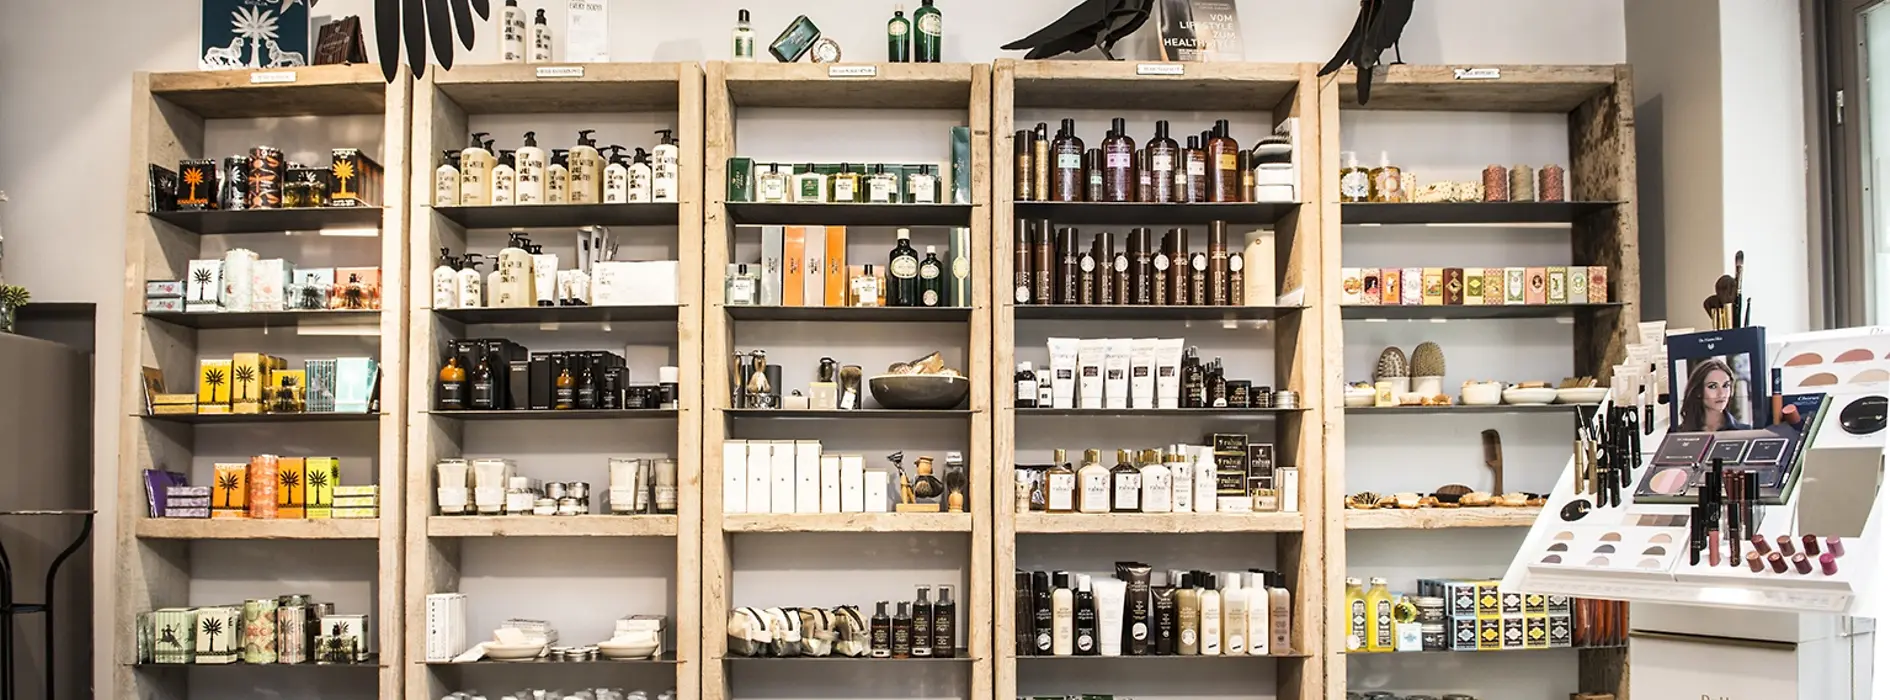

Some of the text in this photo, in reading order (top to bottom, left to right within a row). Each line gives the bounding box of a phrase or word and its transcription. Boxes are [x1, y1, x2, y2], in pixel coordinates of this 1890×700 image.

[1209, 14, 1233, 22] VOM
[1179, 21, 1234, 30] LIFSTYLE
[1213, 31, 1236, 39] ZUM
